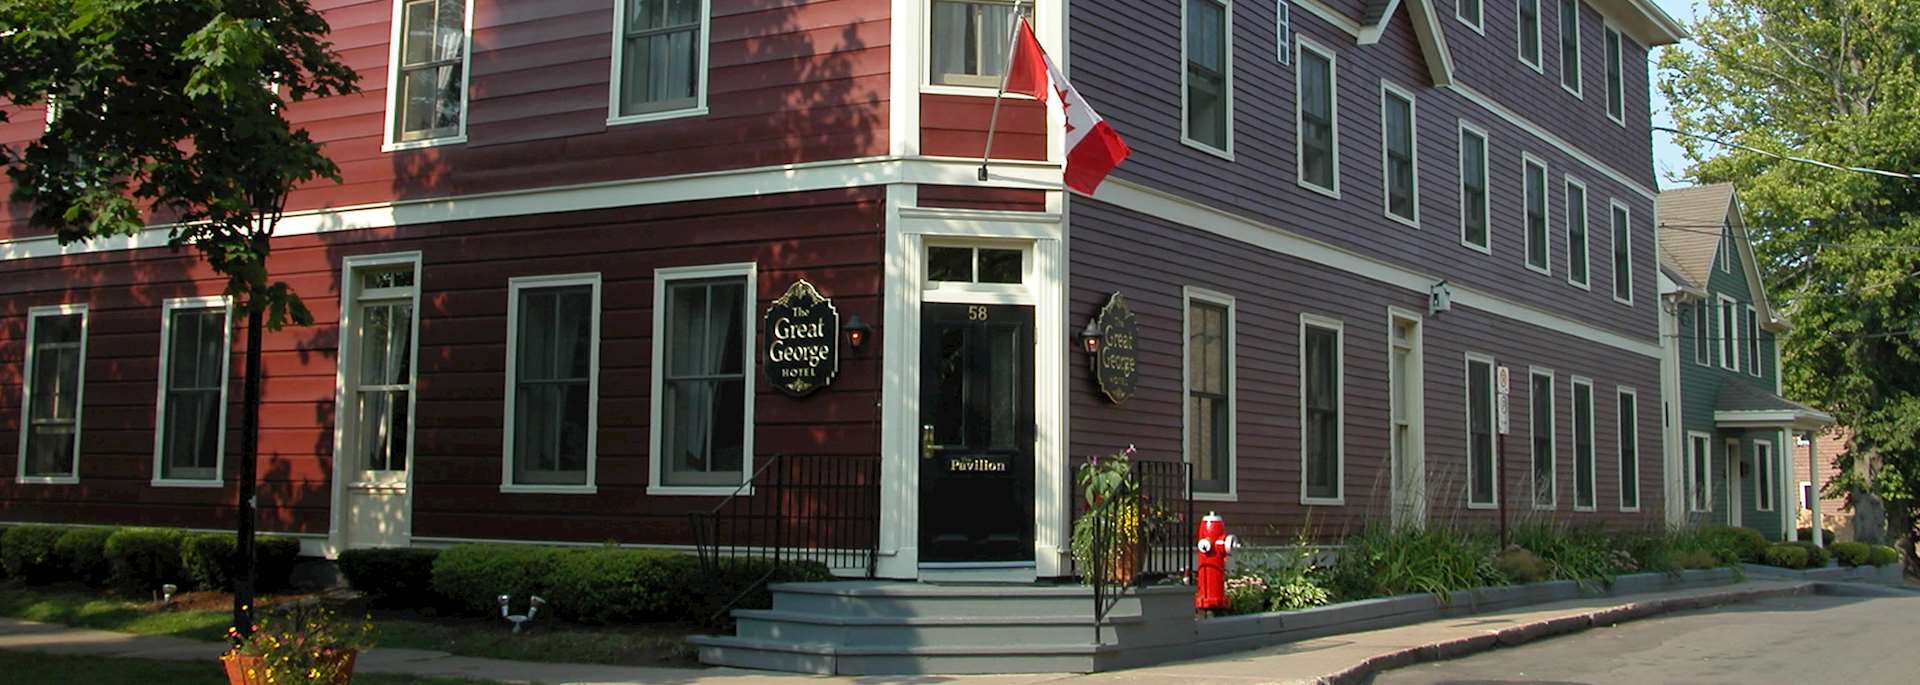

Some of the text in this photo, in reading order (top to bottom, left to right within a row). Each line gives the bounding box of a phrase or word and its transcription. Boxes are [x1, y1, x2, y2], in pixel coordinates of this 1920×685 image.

[792, 307, 810, 317] The
[969, 305, 988, 321] 58
[774, 317, 825, 340] Great
[769, 340, 830, 368] George
[1102, 346, 1136, 378] George
[782, 368, 816, 378] HOTEL
[950, 459, 1006, 471] Pavilion
